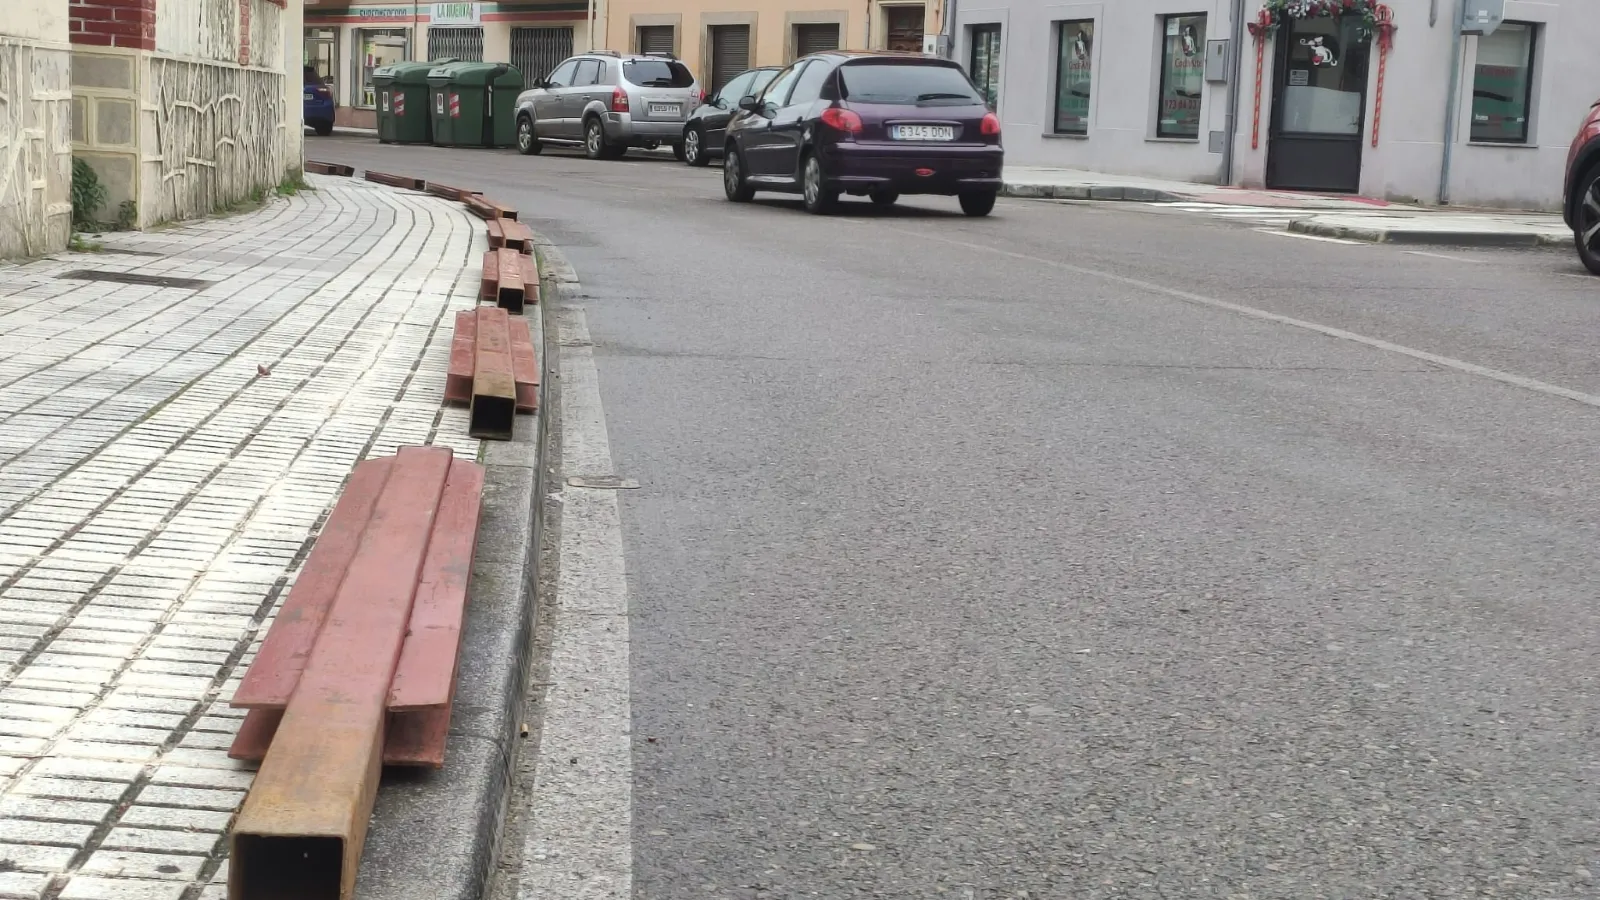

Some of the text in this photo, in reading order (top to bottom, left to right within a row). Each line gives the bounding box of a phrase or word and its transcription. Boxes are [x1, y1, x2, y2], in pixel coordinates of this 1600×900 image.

[437, 3, 446, 17] LA
[900, 126, 951, 137] 6345 DDN
